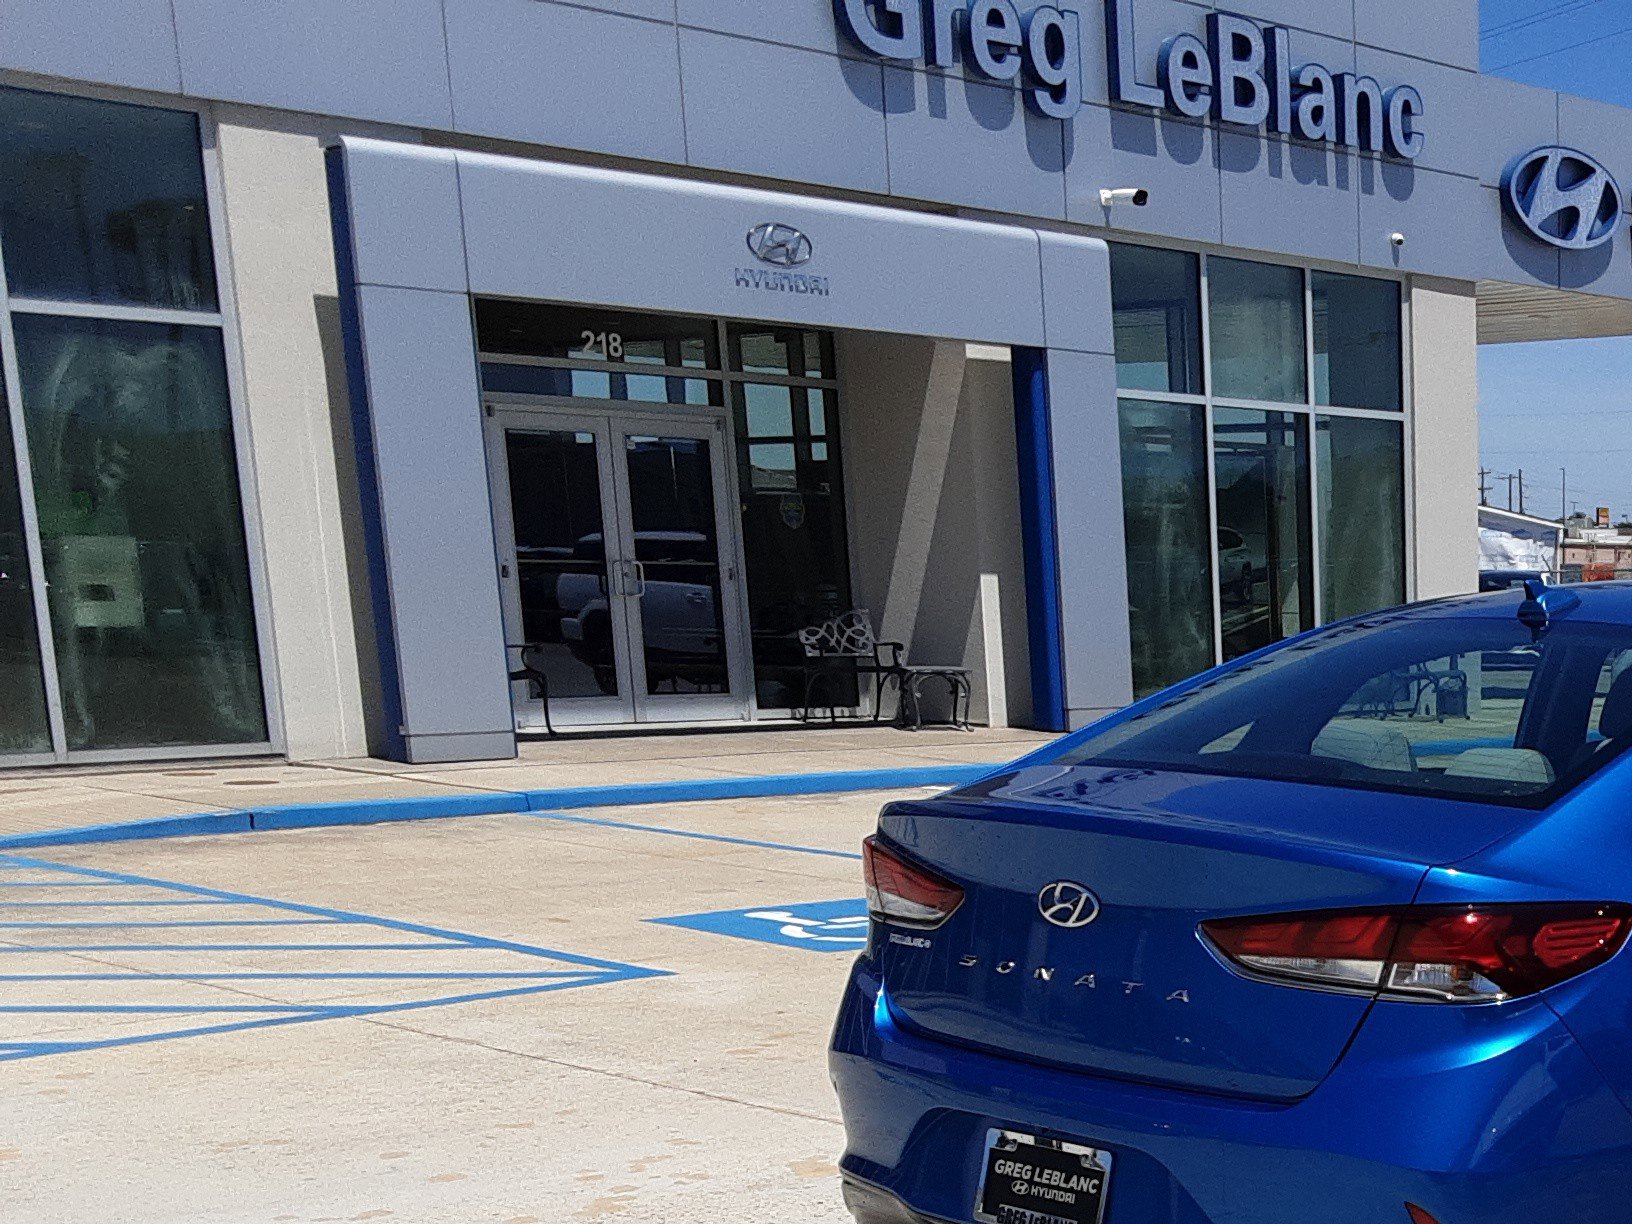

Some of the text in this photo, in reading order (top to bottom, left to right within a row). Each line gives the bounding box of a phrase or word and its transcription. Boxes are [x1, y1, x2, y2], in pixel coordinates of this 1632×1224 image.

[1107, 0, 1426, 159] LeBlanc
[734, 267, 831, 297] HYUNDAI
[581, 330, 623, 358] 218
[958, 954, 1191, 1003] SONATA
[993, 1158, 1100, 1195] GREG LEBLANC
[1030, 1185, 1076, 1205] HYUNDAI
